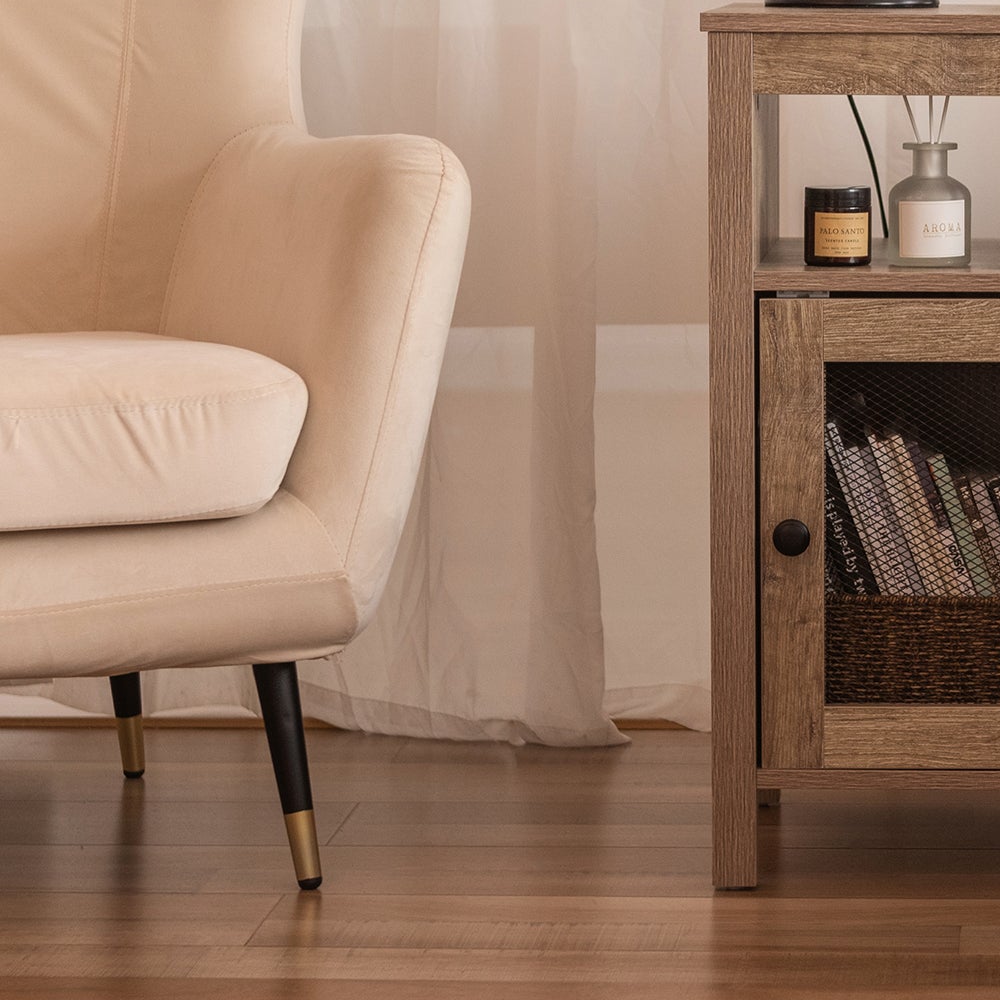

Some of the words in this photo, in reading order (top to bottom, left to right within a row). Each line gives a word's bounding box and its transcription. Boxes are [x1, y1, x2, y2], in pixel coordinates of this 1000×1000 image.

[819, 227, 839, 235] PALO
[840, 227, 865, 235] SANTO
[922, 222, 961, 233] AROMA
[826, 511, 855, 556] played
[846, 556, 858, 573] by
